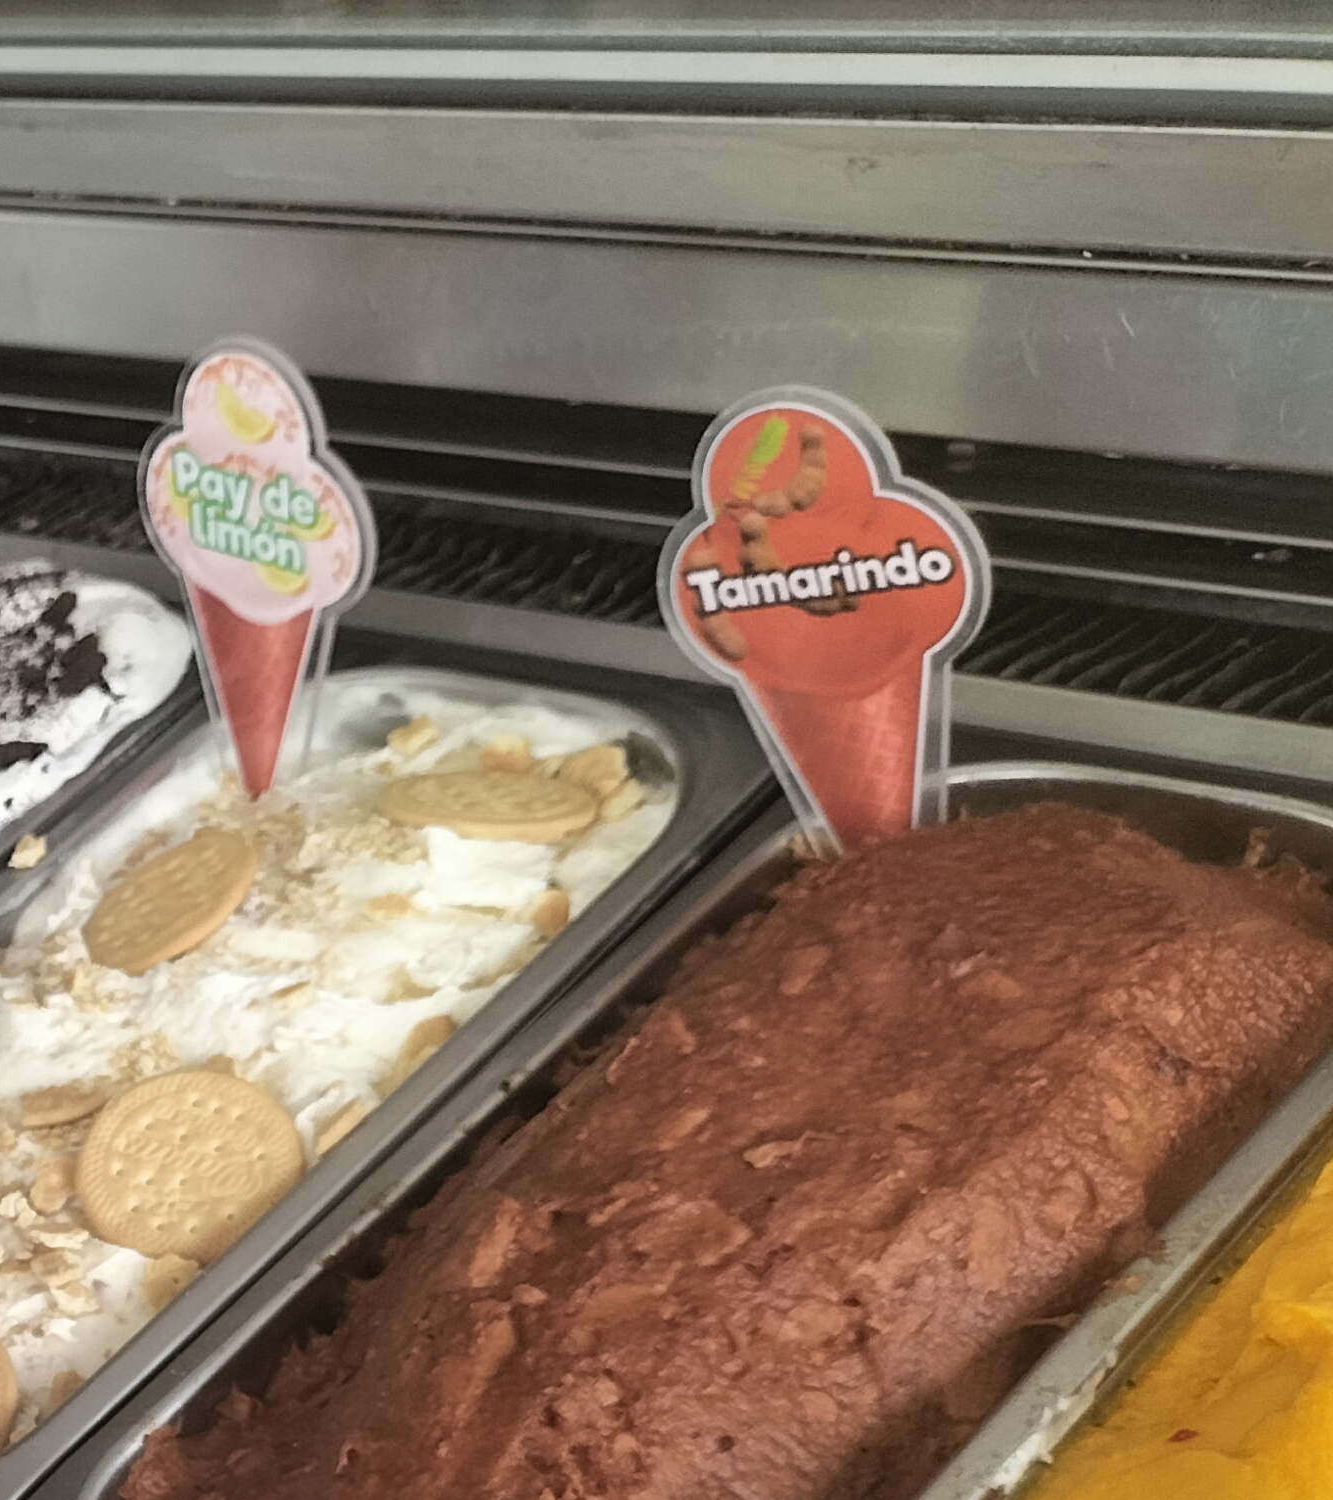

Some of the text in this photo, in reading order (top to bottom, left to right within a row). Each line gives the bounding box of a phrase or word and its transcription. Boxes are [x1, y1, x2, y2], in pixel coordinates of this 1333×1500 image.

[171, 449, 319, 527] Pay de
[190, 499, 305, 573] limón
[686, 540, 953, 614] Tamarindo
